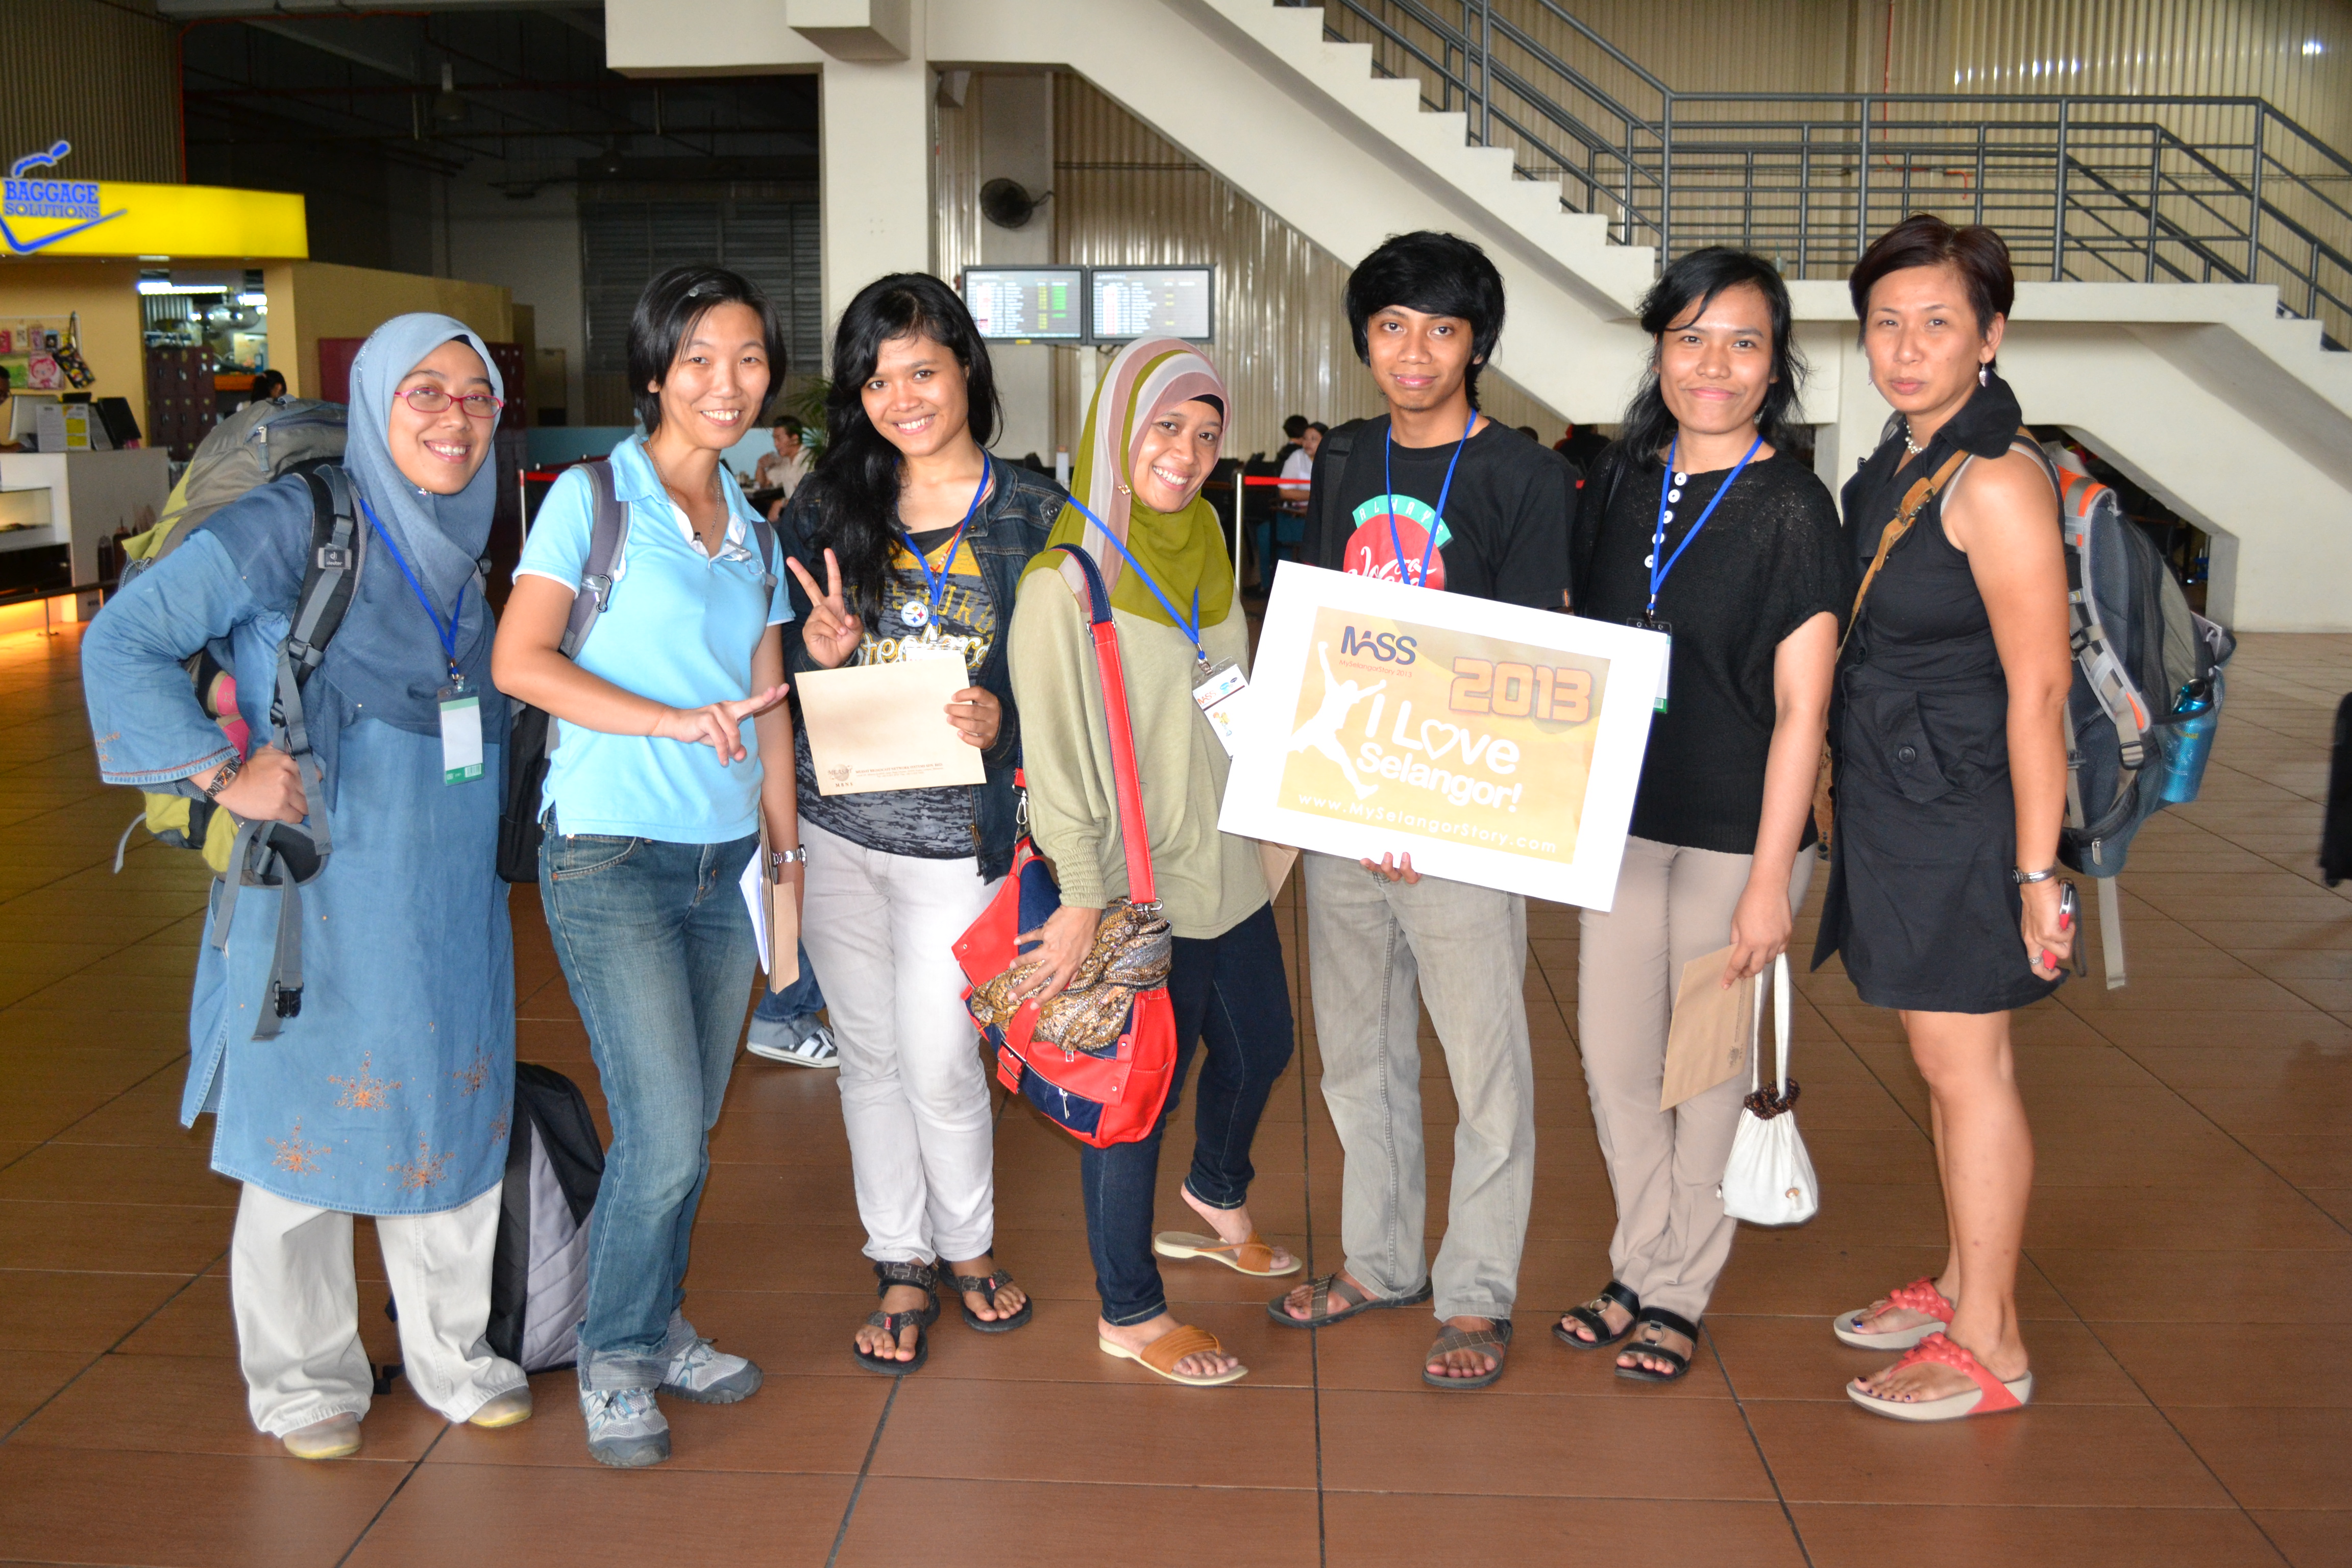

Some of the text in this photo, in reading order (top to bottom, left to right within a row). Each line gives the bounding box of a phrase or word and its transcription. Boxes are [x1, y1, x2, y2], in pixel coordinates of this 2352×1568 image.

[5, 181, 98, 204] BAGGAGE
[5, 203, 100, 218] SOLUTIONS
[1359, 498, 1443, 535] ALWAYS
[1339, 659, 1412, 678] MySelangorStory 2013
[1448, 656, 1592, 723] 2013
[1364, 693, 1385, 738] I
[1356, 742, 1523, 813] Selangor!
[1298, 794, 1557, 853] www.MySelangorStory.com
